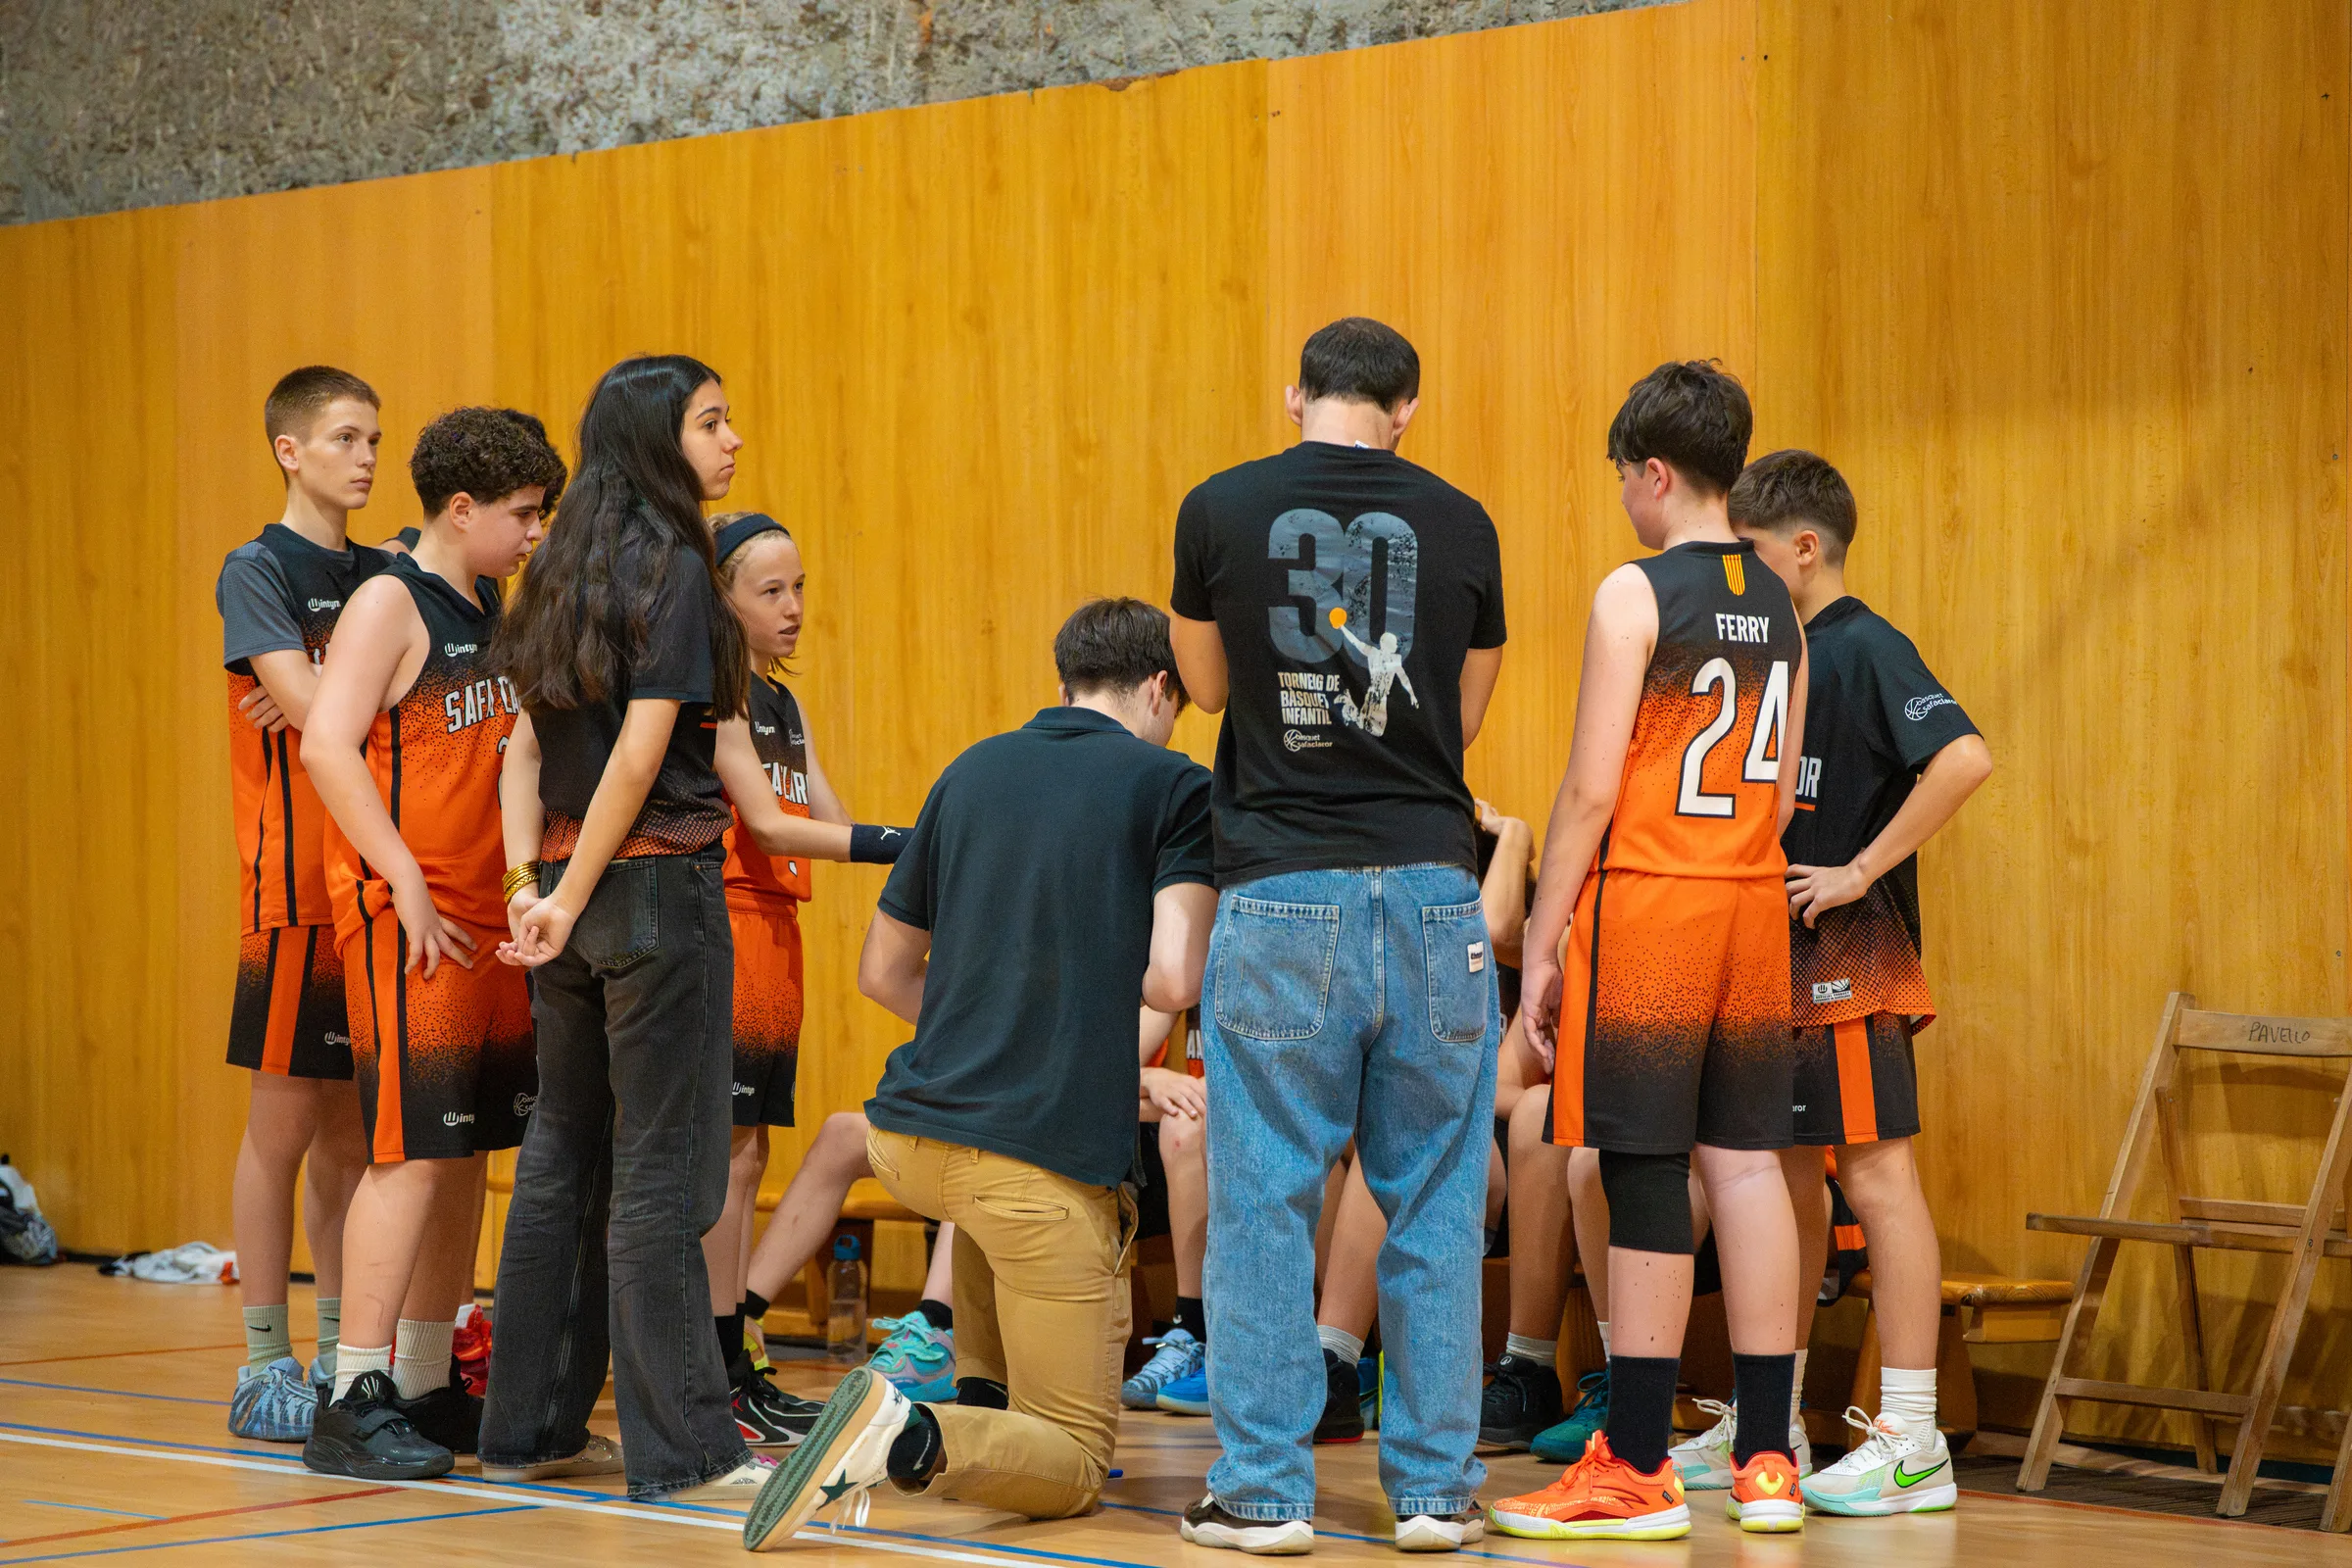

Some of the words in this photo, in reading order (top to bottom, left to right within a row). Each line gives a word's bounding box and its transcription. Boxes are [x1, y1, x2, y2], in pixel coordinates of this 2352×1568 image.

[1268, 509, 1418, 668] 30
[1716, 612, 1769, 643] FERRY
[1277, 671, 1324, 691] TORNEIG
[1326, 674, 1340, 692] DE
[1281, 708, 1332, 725] INFANTIL
[1676, 656, 1788, 818] 24
